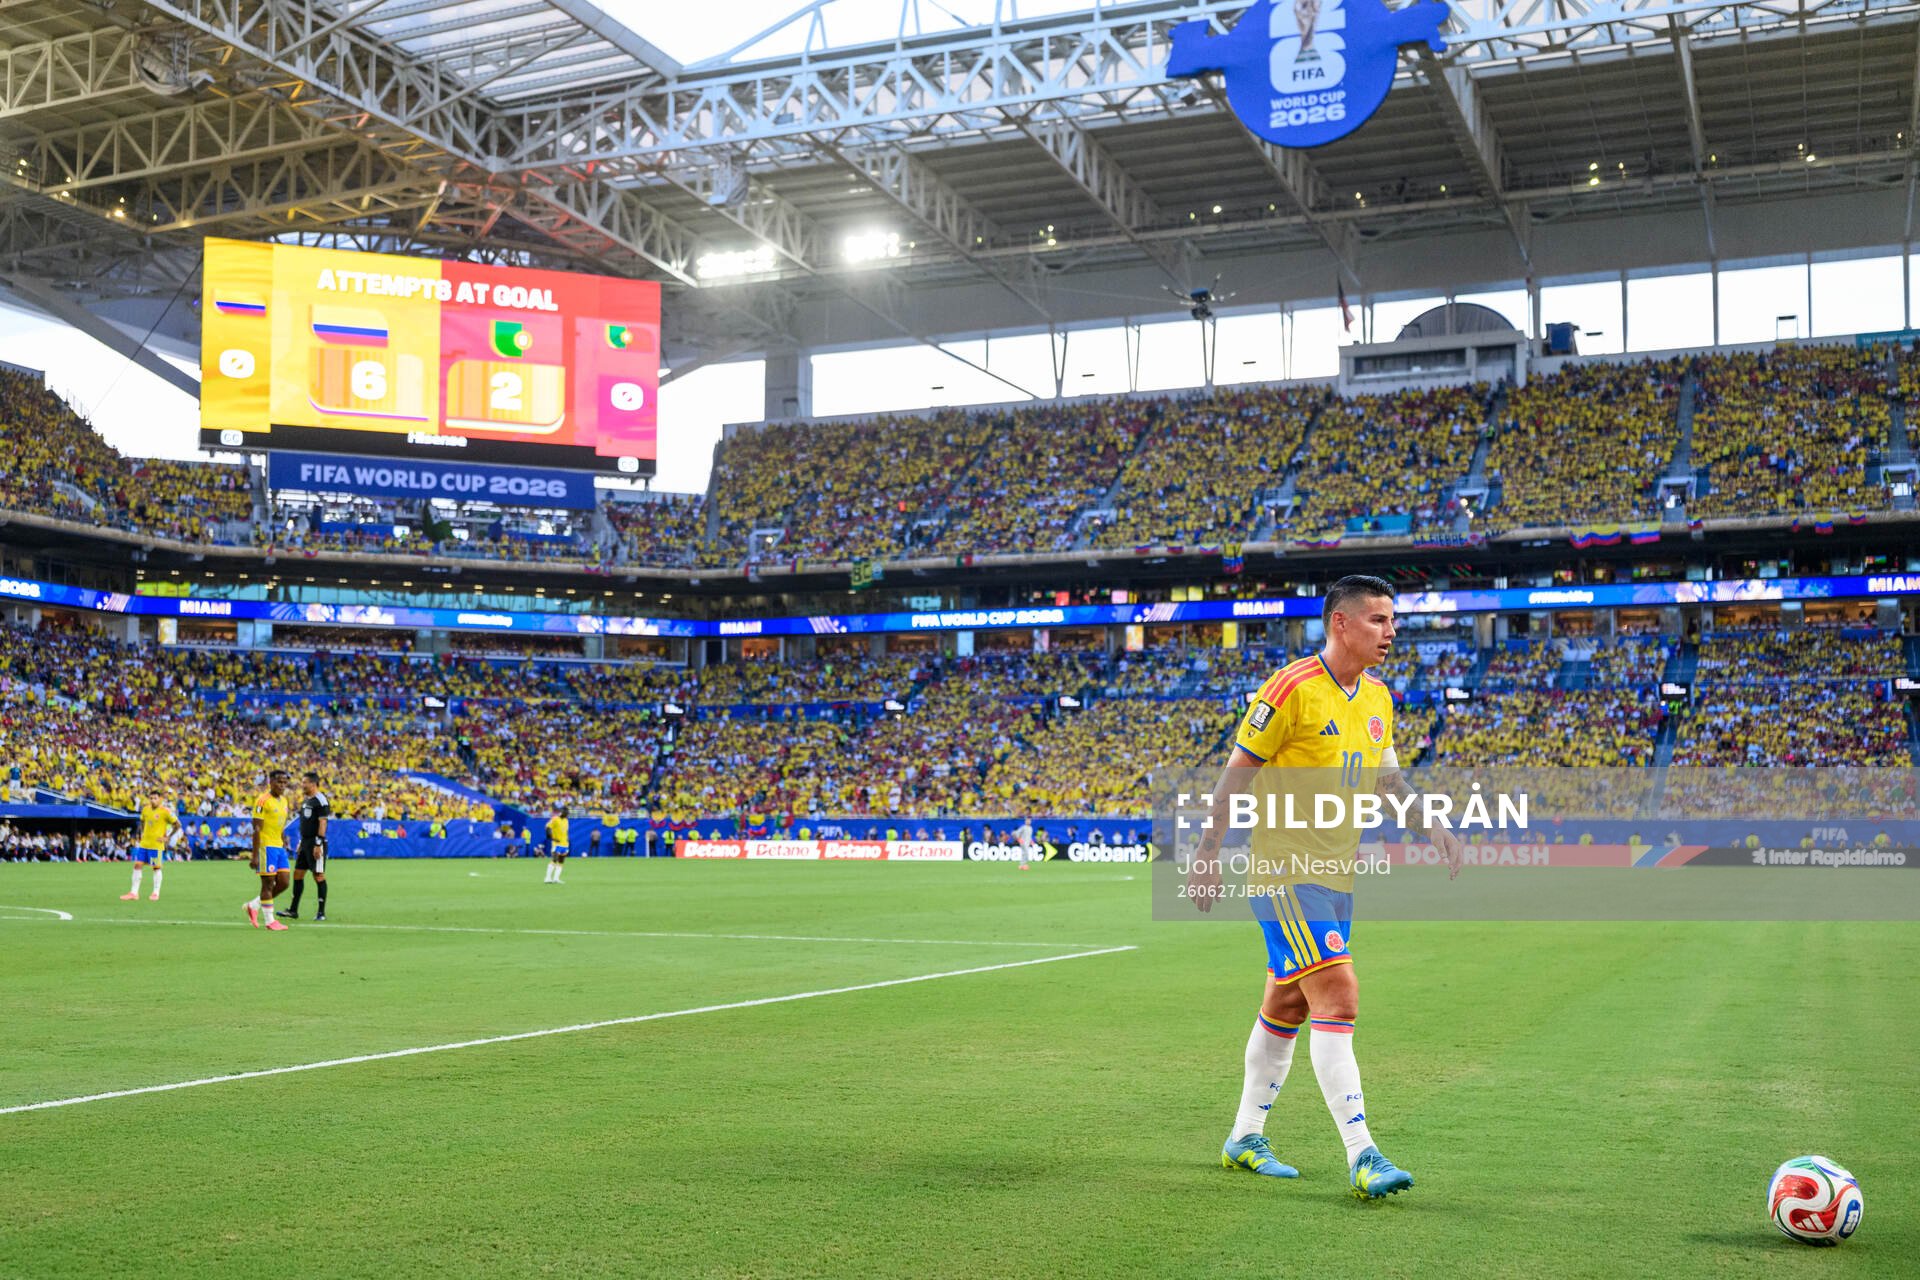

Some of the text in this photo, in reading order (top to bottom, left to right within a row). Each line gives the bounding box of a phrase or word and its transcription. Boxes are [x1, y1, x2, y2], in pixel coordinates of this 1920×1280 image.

[1292, 67, 1326, 82] FIFA
[1270, 90, 1347, 110] WORLD CUP
[1269, 103, 1347, 129] 2026
[317, 269, 559, 312] ATTEMPTS AT GOAL
[219, 349, 255, 379] 0
[351, 360, 387, 400] 6
[490, 371, 523, 410] 2
[610, 382, 644, 411] 0
[301, 463, 568, 498] FIFA WORLD CUP 2026
[179, 600, 232, 615] MIAMI
[1233, 601, 1285, 616] MIAMI
[719, 621, 762, 635] MIAMI
[911, 614, 940, 628] FIFA
[940, 612, 988, 627] WORLD
[988, 611, 1016, 624] CUP
[1340, 751, 1363, 788] 10
[1812, 827, 1849, 841] FIFA
[684, 842, 741, 858] Betano
[756, 844, 810, 857] Betano
[825, 842, 881, 858] Betano
[898, 844, 953, 857] Betano
[1067, 842, 1148, 863] Globant
[1404, 845, 1550, 865] DORDASH
[1769, 849, 1808, 865] Inter
